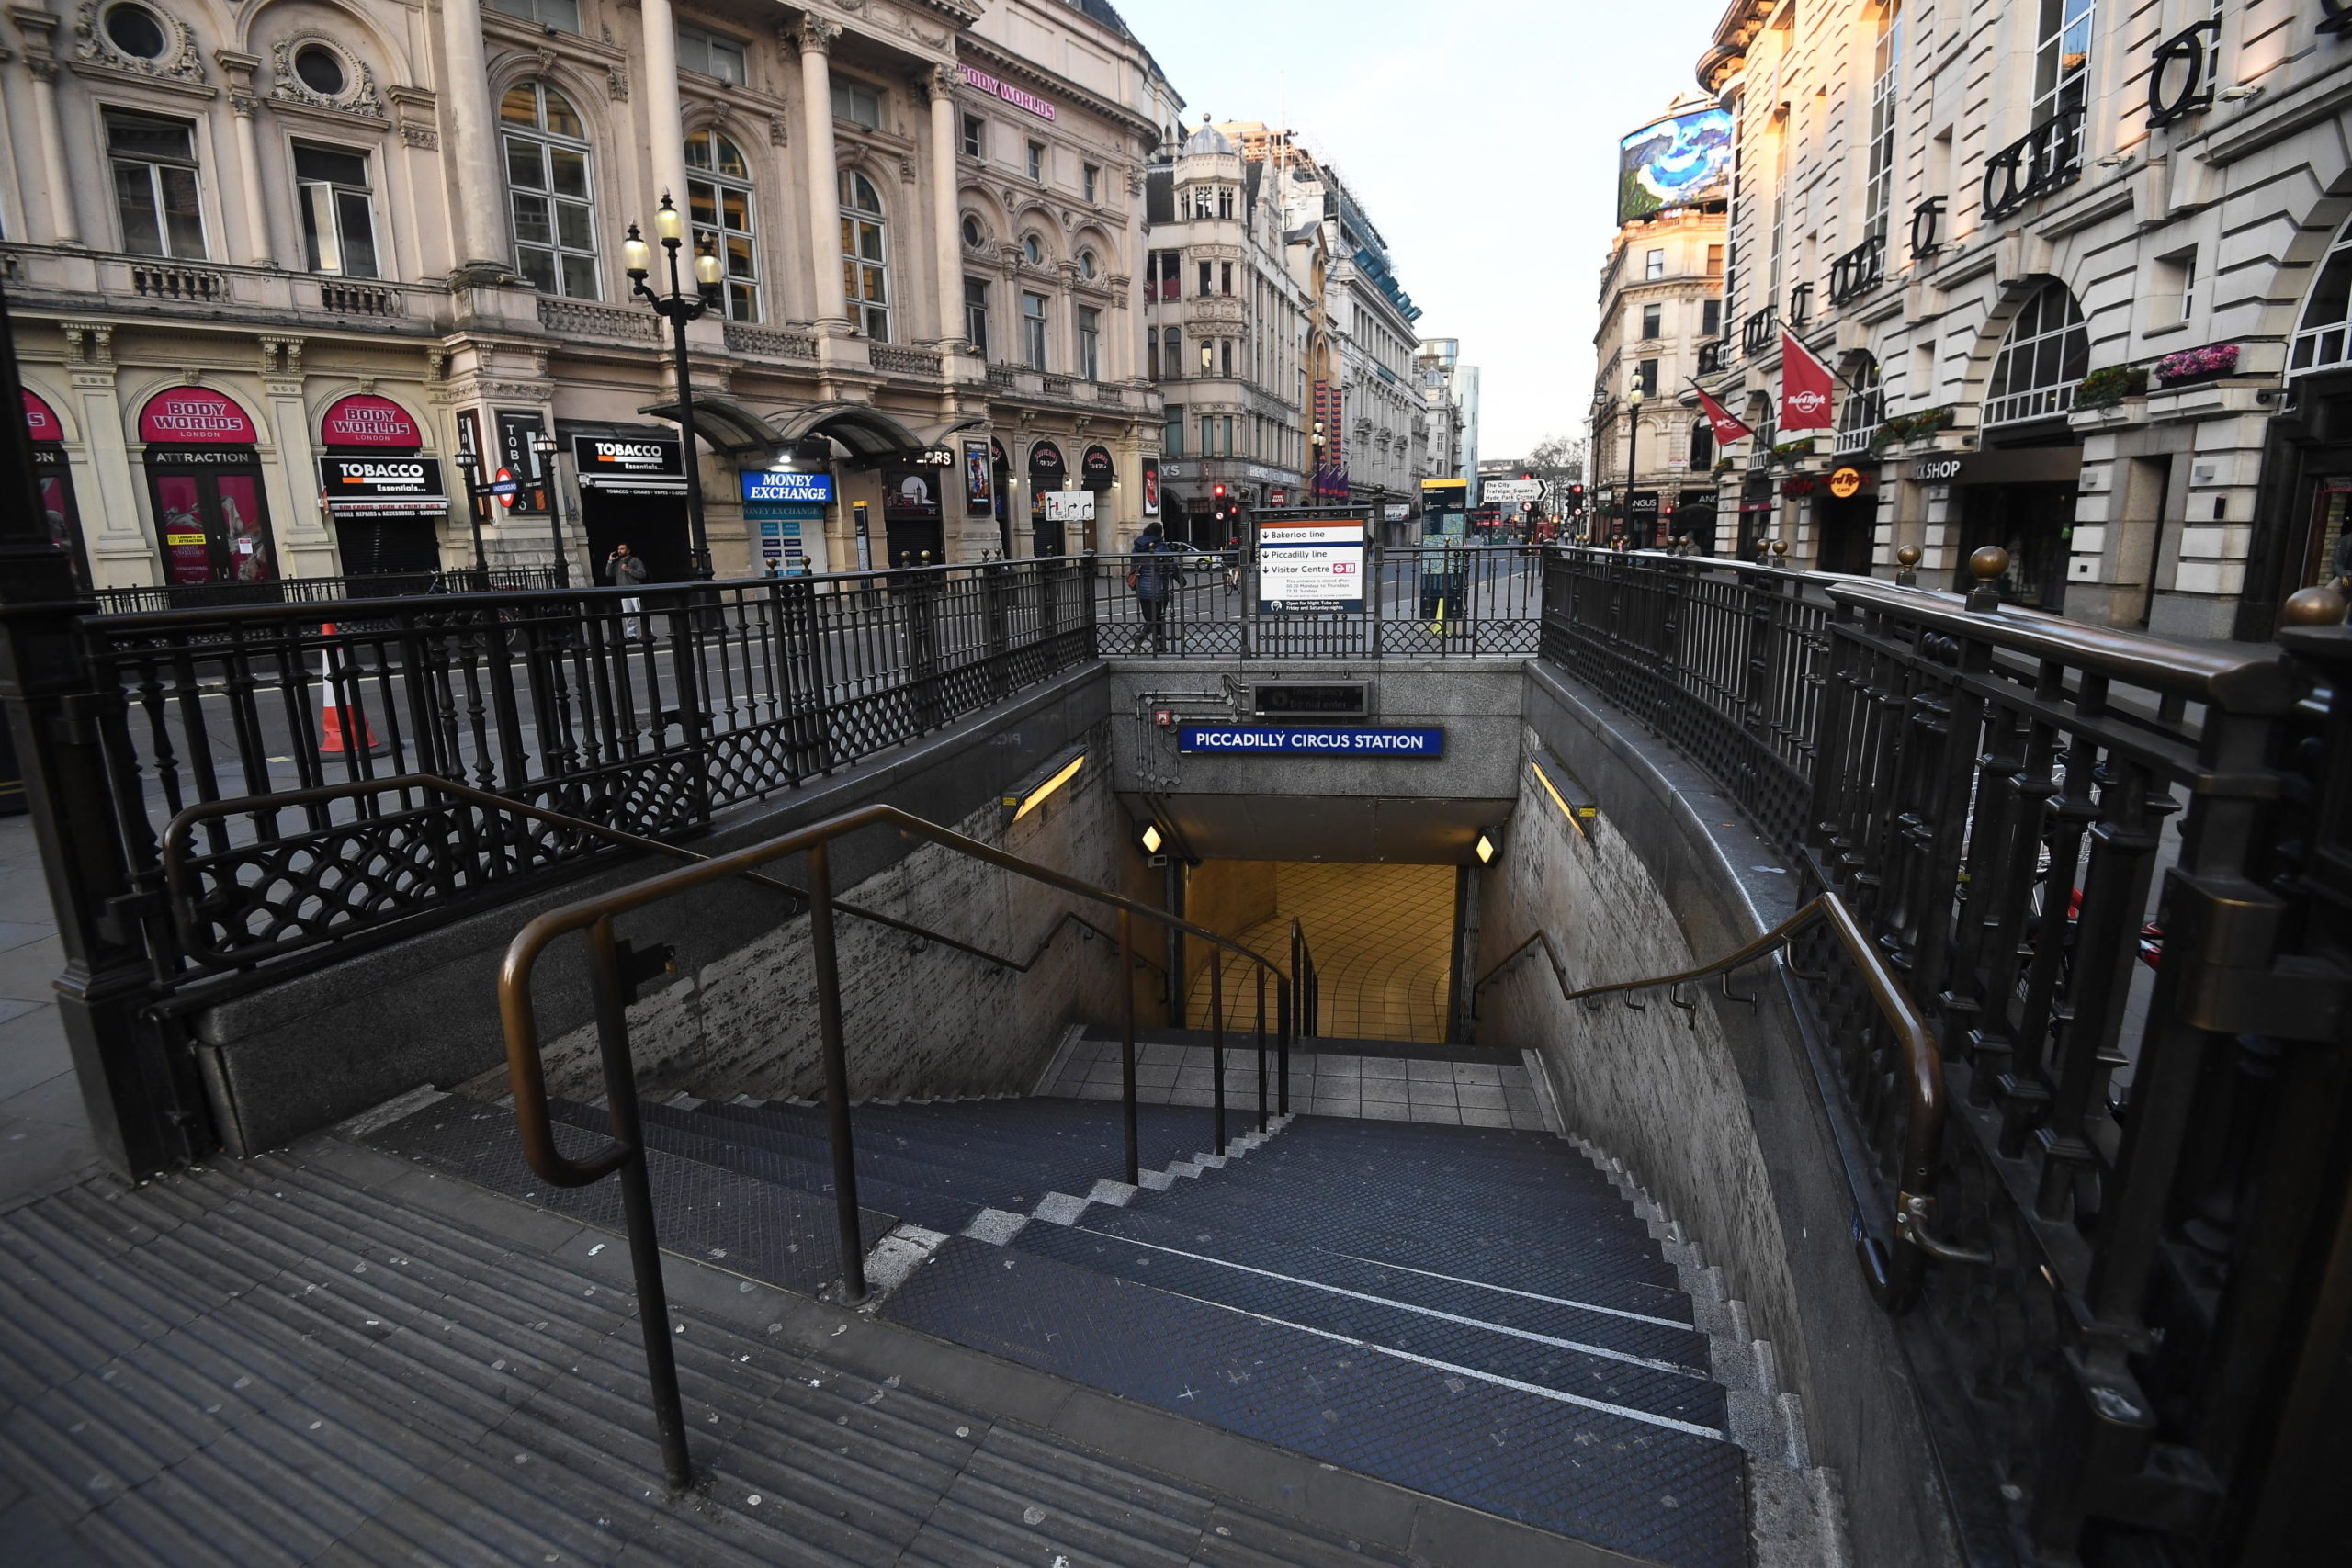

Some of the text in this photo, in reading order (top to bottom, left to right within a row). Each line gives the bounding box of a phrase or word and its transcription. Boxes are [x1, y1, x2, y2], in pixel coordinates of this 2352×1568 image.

[998, 81, 1056, 121] WORLDS
[166, 402, 227, 416] BODY
[345, 407, 396, 422] BODY
[152, 415, 243, 430] WORLDS
[333, 420, 410, 434] WORLDS
[595, 443, 662, 457] TOBACCO
[156, 453, 249, 463] ATTRACTION
[339, 463, 424, 477] TOBACCO
[1926, 460, 1961, 479] SHOP
[762, 473, 814, 487] MONEY
[751, 487, 826, 500] EXCHANGE
[772, 506, 818, 515] EXCHANGE
[1271, 531, 1306, 539] Bakerloo
[1271, 551, 1309, 559] Piccadilly
[1301, 565, 1329, 573] Centre
[1196, 732, 1423, 750] PICCADILLY CIRCUS STATION
